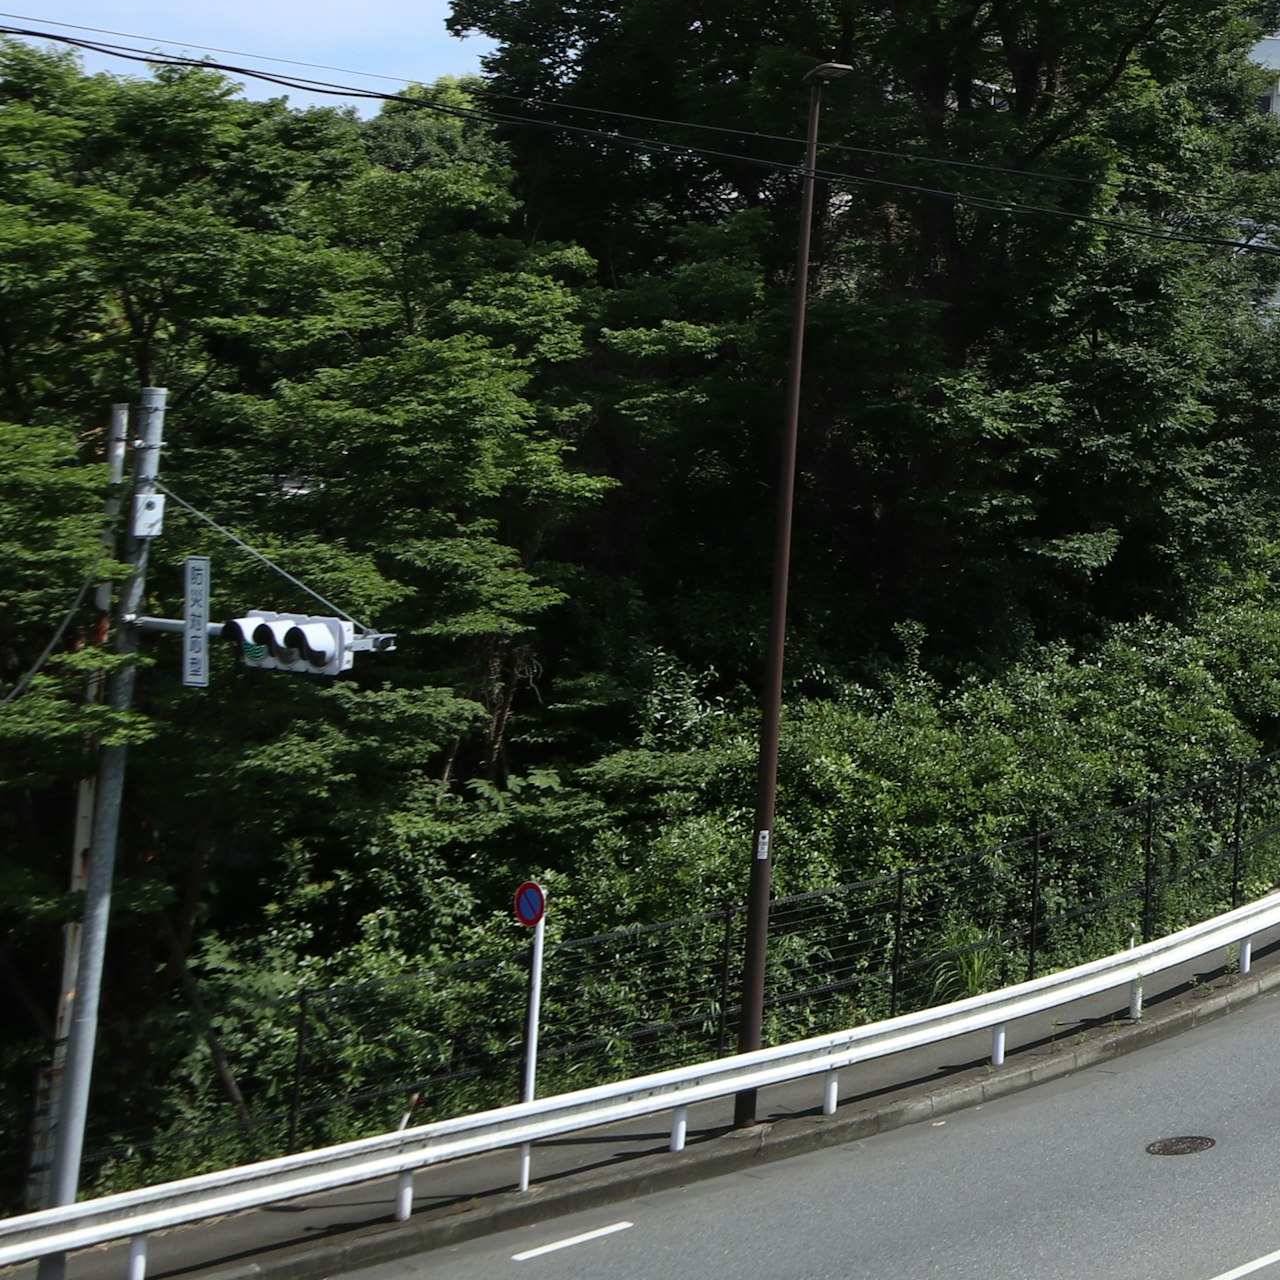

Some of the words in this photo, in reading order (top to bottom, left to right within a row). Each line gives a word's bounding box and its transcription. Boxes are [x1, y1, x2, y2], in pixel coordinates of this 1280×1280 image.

[189, 566, 204, 676] 防災対応型
